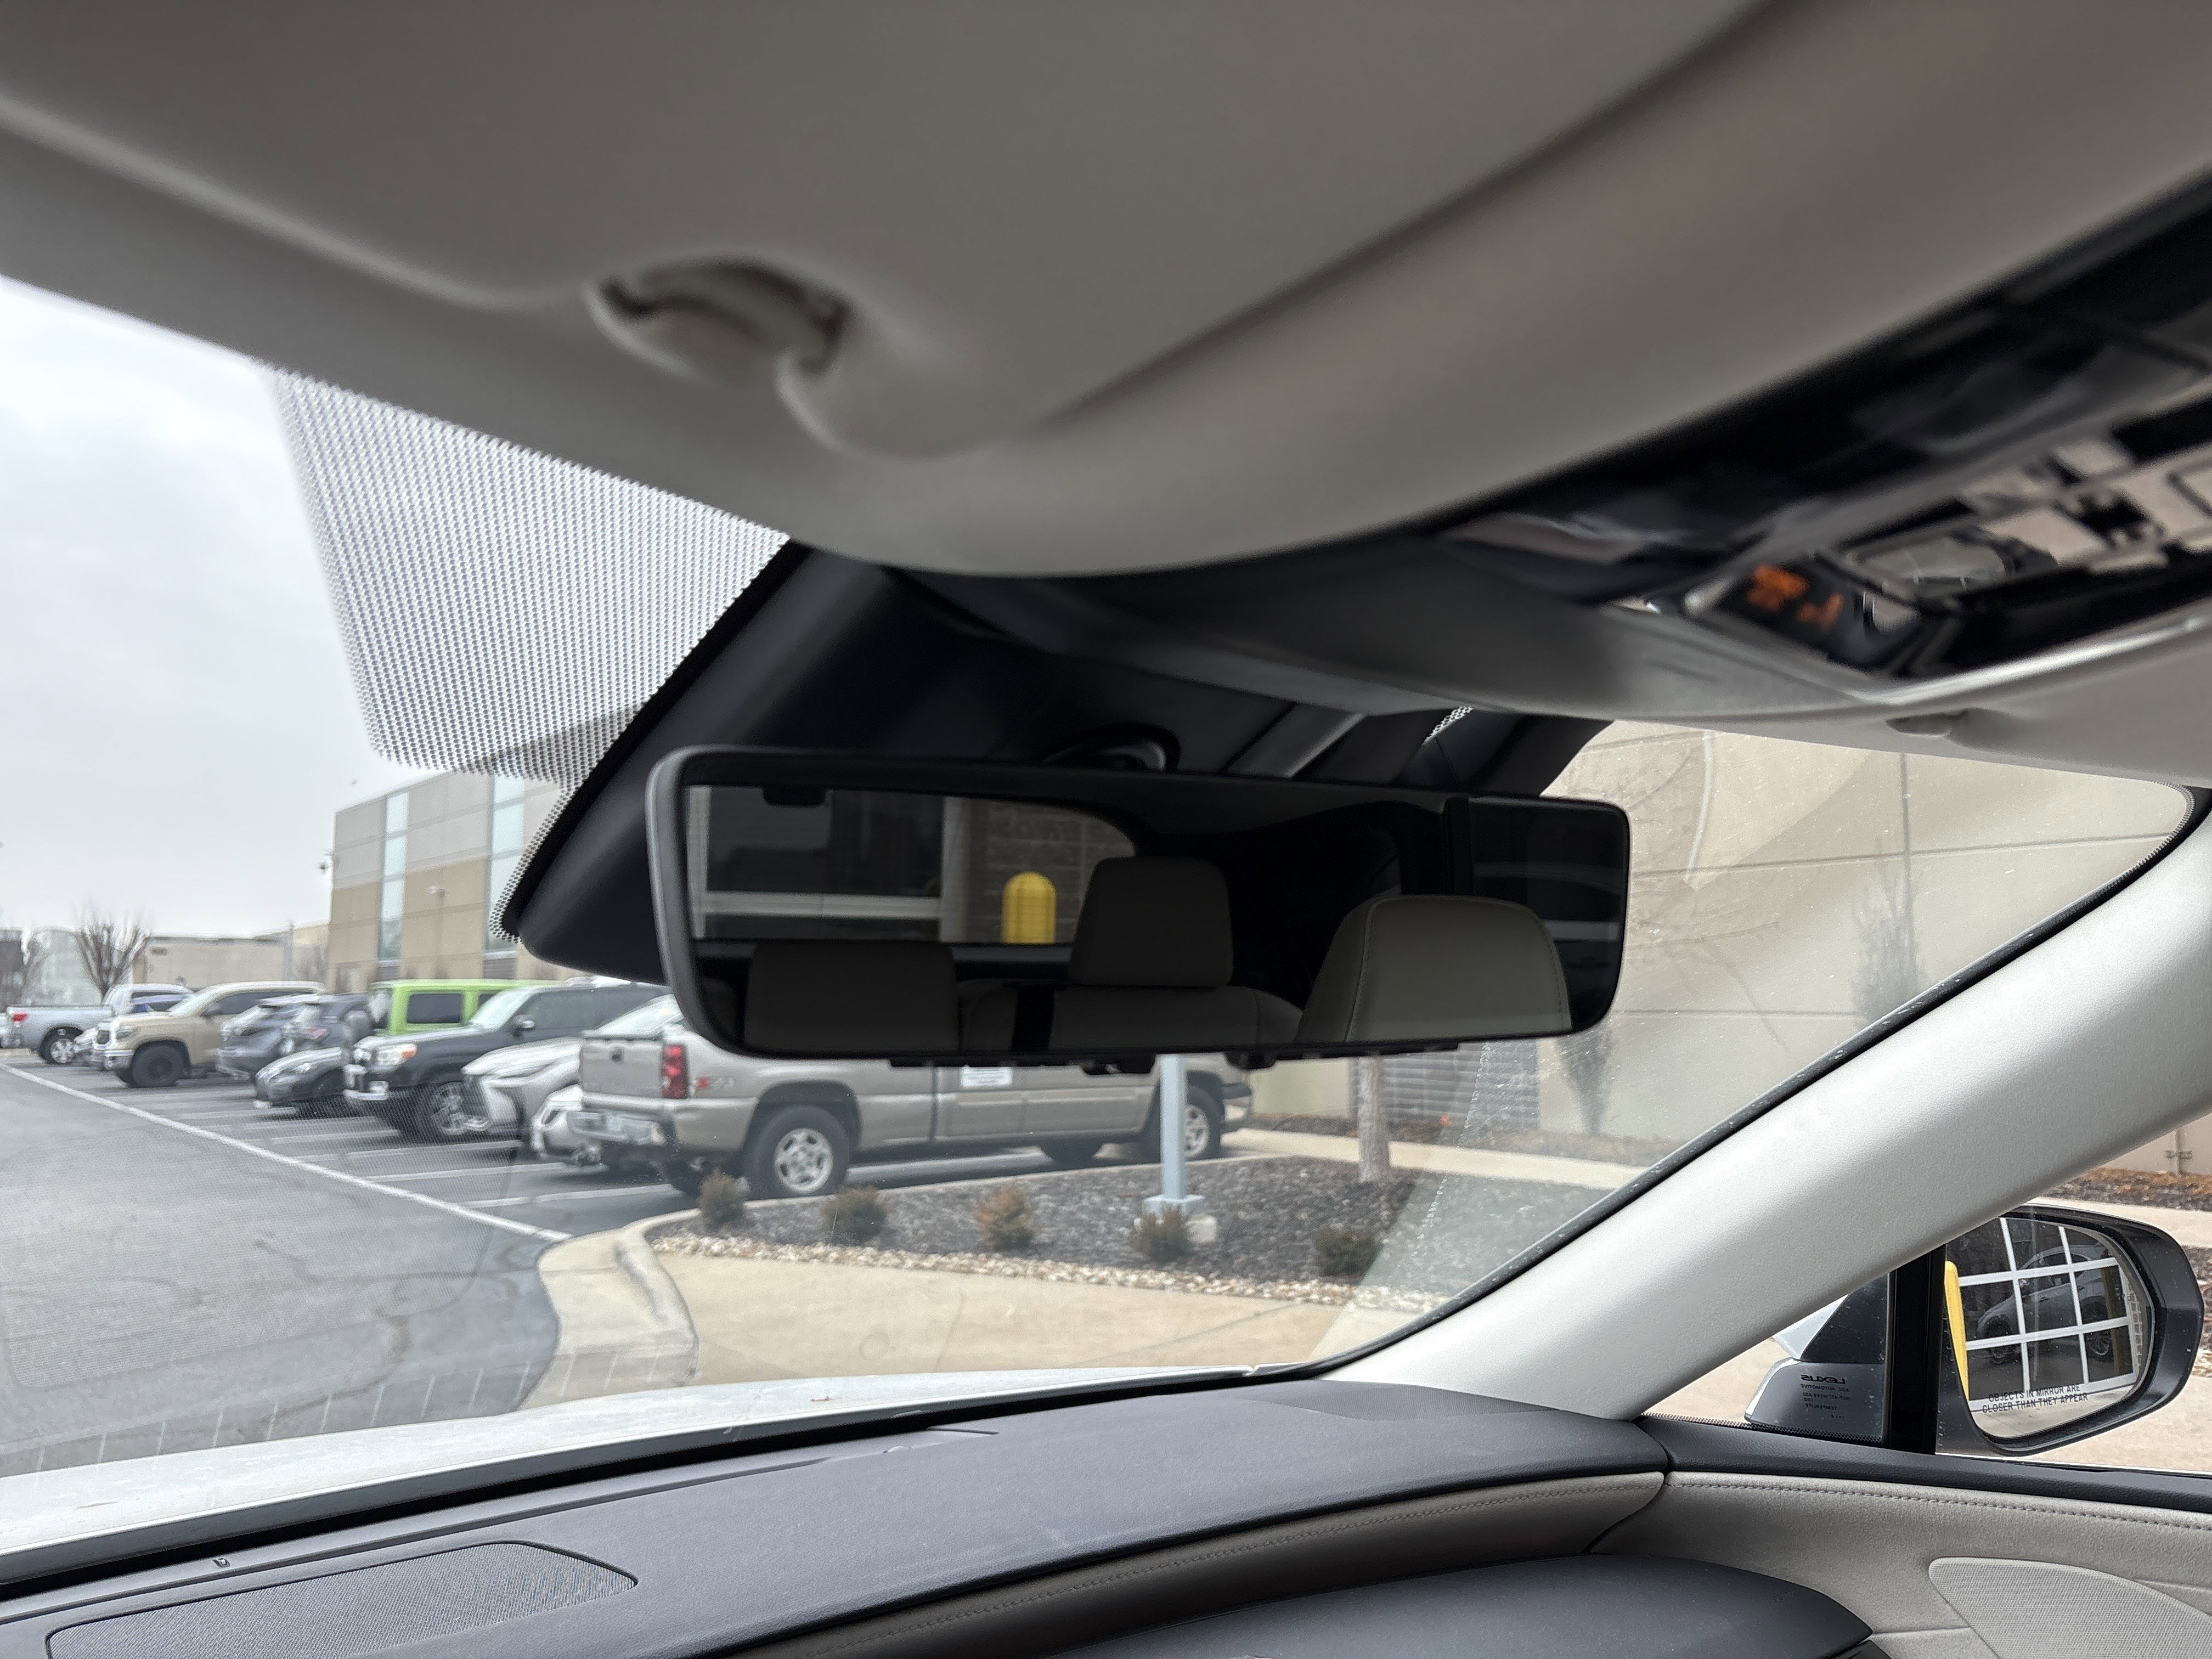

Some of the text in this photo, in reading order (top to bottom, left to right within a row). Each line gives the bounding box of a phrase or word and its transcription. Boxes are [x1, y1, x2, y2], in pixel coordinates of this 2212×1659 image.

[1982, 1392, 2088, 1413] CLOSER THAN THEY APPEAR
[1989, 1384, 2080, 1402] OBJECTS IN MIRROR ARE
